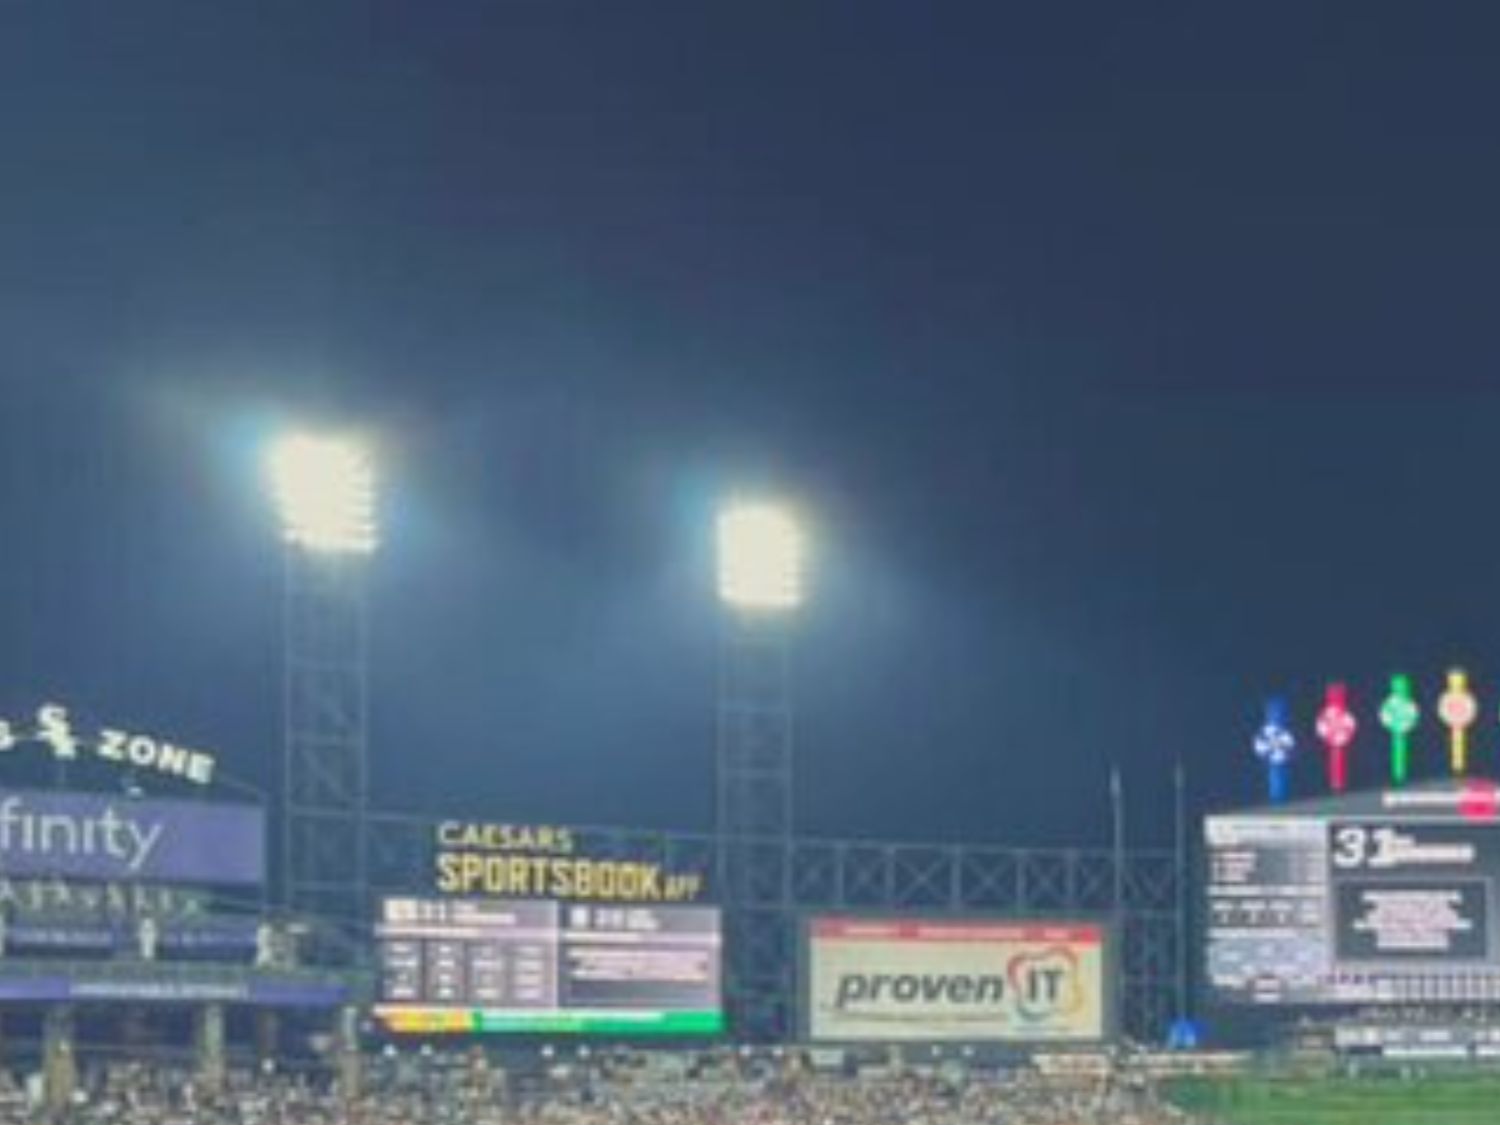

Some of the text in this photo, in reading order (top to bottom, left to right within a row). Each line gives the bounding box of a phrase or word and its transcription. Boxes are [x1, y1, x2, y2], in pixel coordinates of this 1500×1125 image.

[99, 730, 214, 783] ZONE
[438, 820, 573, 853] CAESARS
[436, 852, 660, 899] SPORTSBOOK
[835, 967, 1064, 1007] proven IT
